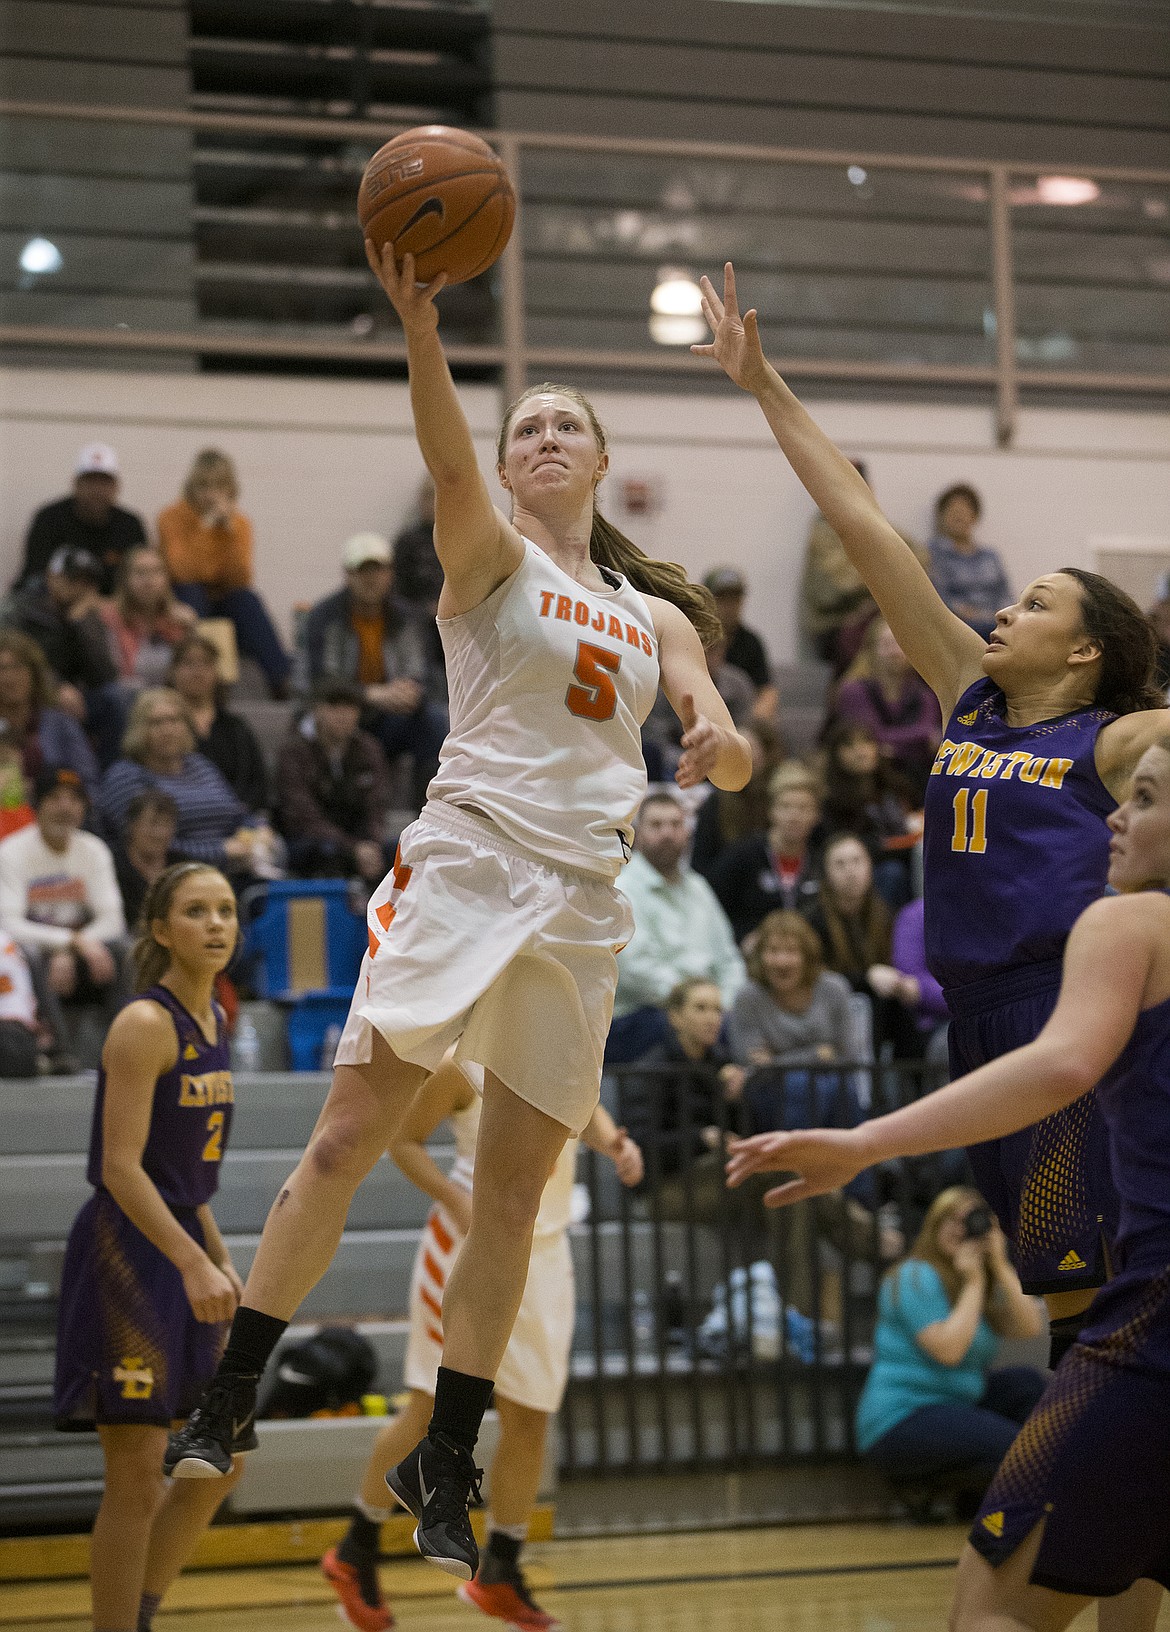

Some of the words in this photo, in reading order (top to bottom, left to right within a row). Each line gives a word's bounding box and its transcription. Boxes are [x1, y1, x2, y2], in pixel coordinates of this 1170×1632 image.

[539, 589, 653, 658] TROJANS
[564, 638, 622, 723] 5
[930, 739, 1074, 789] EWISTON
[951, 787, 989, 854] 11
[202, 1111, 225, 1162] 2
